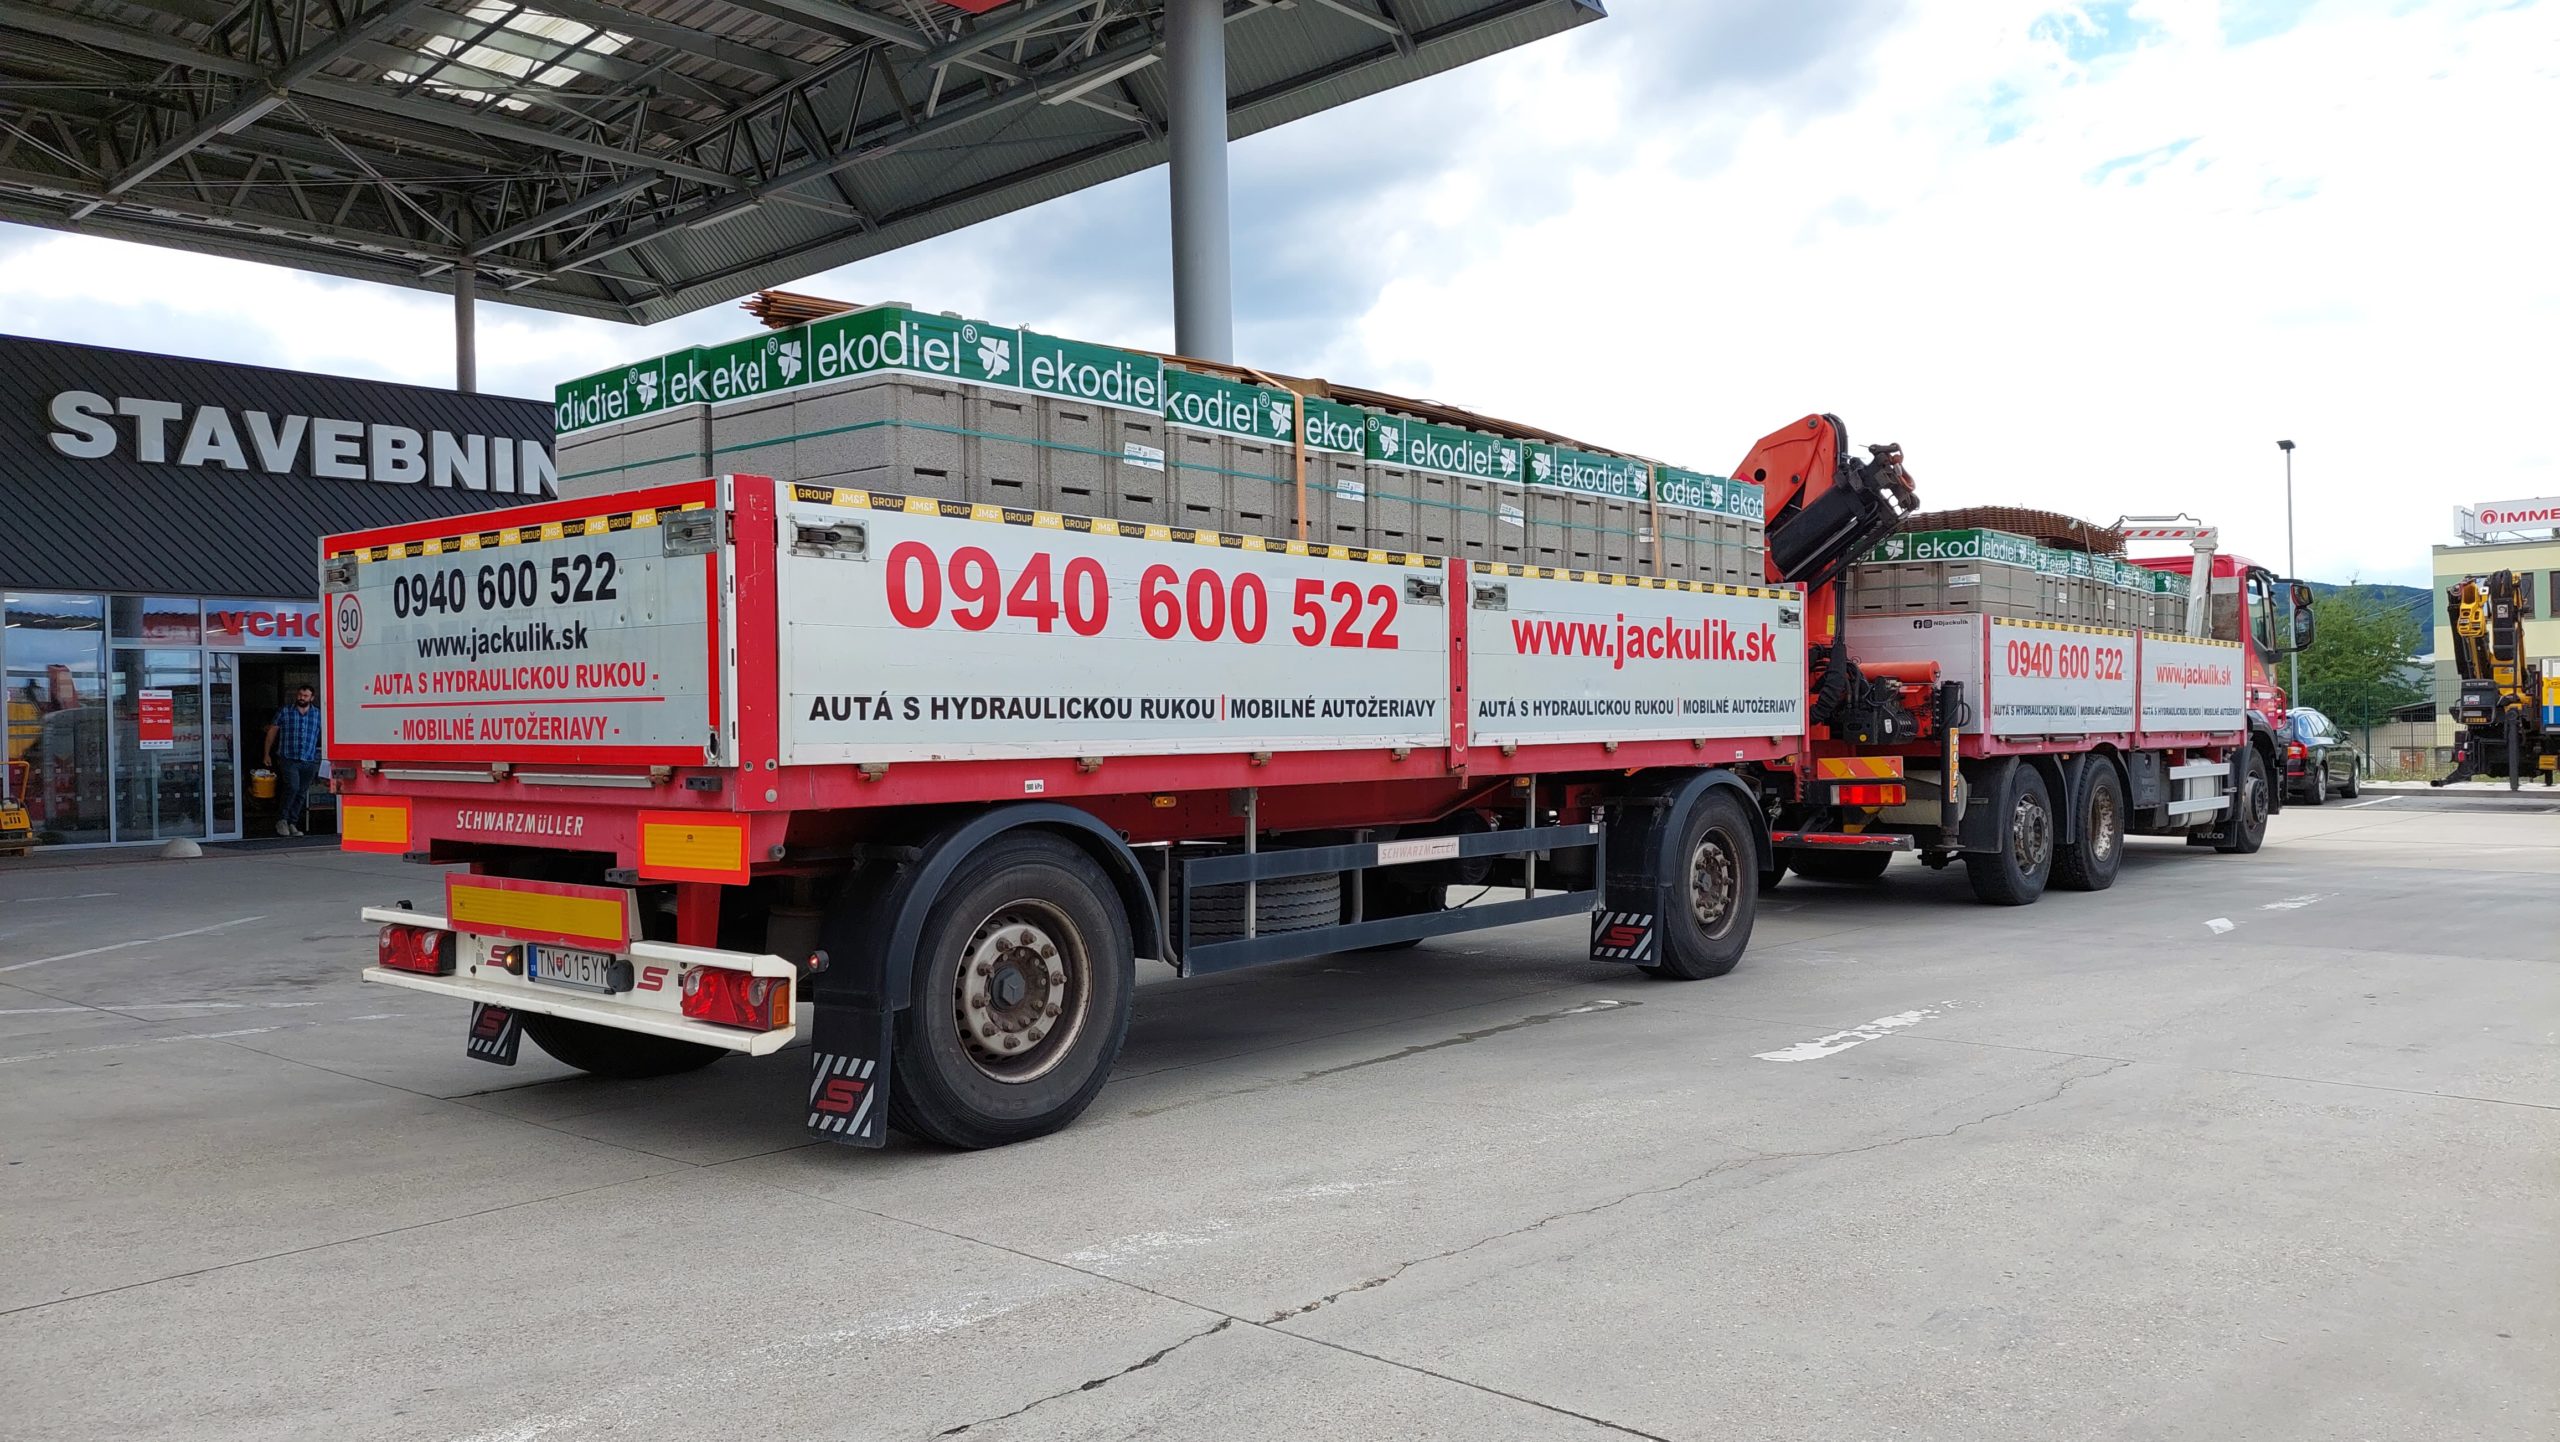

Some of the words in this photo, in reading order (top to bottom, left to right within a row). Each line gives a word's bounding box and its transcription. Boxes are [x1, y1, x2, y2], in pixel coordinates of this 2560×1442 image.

[798, 488, 832, 501] GROUP
[839, 492, 865, 504] JM&F
[872, 496, 904, 508] GROUP
[941, 504, 971, 516] GROUP
[1005, 512, 1033, 523] GROUP
[1064, 518, 1091, 530] GROUP
[521, 529, 541, 540] GROUP
[563, 523, 585, 535] GROUP
[609, 517, 632, 529] GROUP
[394, 568, 466, 619] 0940
[477, 560, 538, 611] 600
[550, 552, 617, 604] 522
[886, 541, 1110, 636] 0940
[1139, 564, 1268, 642] 600
[1292, 578, 1399, 649] 522
[341, 609, 358, 632] 90
[417, 619, 589, 662] www.jackulik.sk
[1511, 613, 1777, 670] www.jackulik.sk
[2007, 640, 2053, 678] 0940
[2059, 644, 2089, 679] 600
[2095, 647, 2123, 680] 522
[2156, 662, 2232, 689] www.jackulik.sk
[418, 672, 428, 694] S
[433, 664, 569, 693] HYDRAULICKOU
[576, 662, 646, 688] RUKOU
[809, 690, 894, 721] AUTÁ
[903, 696, 920, 720] S
[931, 696, 1133, 720] HYDRAULICKOU
[1140, 698, 1215, 719] RUKOU
[1231, 694, 1315, 719] MOBILNÉ
[1321, 694, 1436, 718] AUTOŽERIAVY
[1478, 697, 1517, 718] AUTÁ
[1521, 700, 1529, 717] S
[1533, 700, 1631, 717] HYDRAULICKOU
[1635, 700, 1674, 715] RUKOU
[1683, 696, 1730, 714] MOBILNÉ
[1732, 696, 1797, 714] AUTOŽERIAVY
[403, 713, 474, 741] MOBILNÉ
[480, 710, 608, 740] AUTOŽERIAVY
